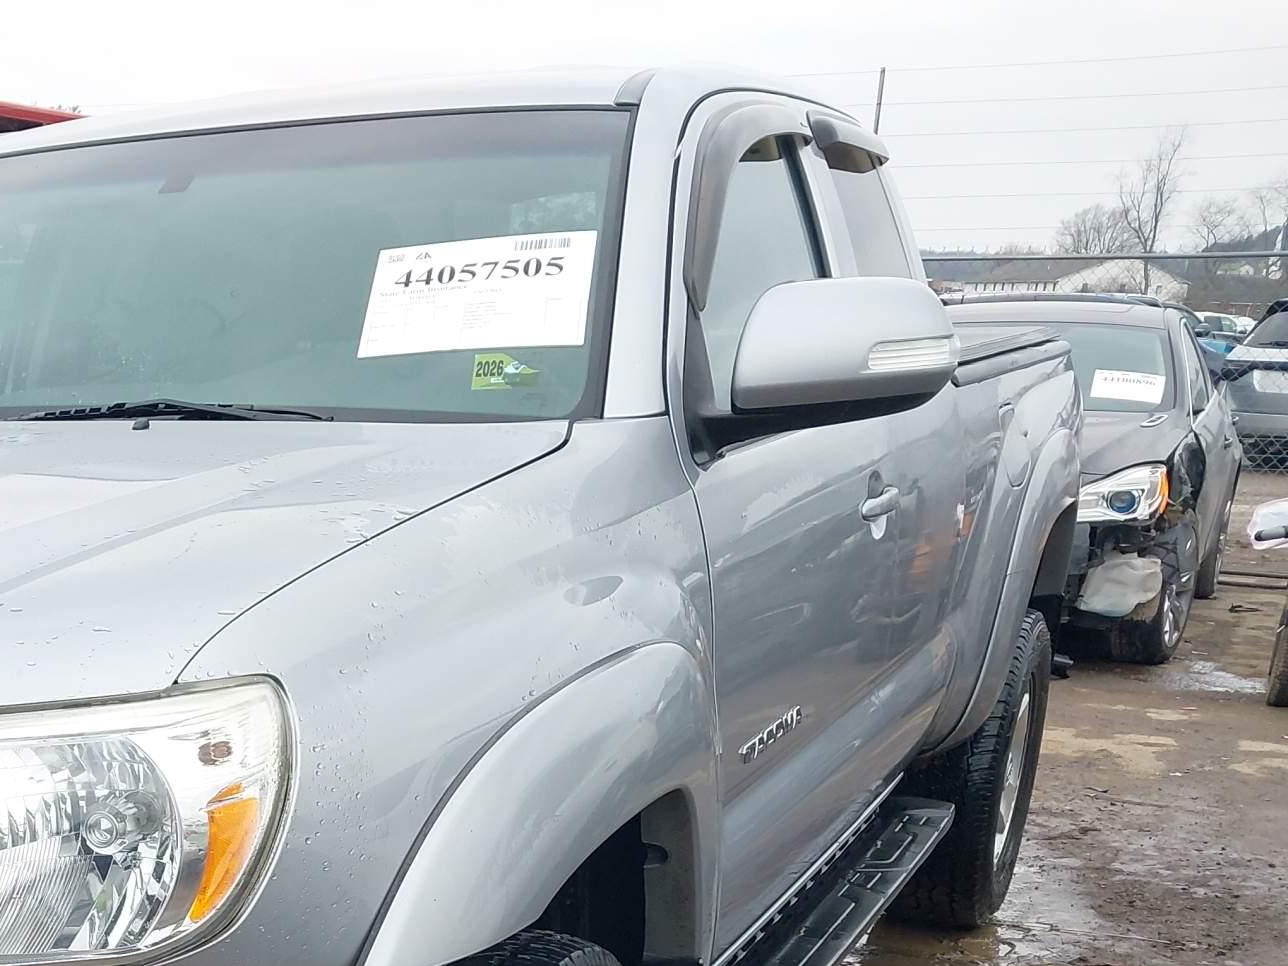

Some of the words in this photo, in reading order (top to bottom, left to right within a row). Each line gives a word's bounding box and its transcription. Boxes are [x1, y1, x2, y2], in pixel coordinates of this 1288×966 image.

[394, 256, 567, 288] 44057505
[475, 360, 504, 377] 2026
[738, 706, 803, 763] TACOMA
